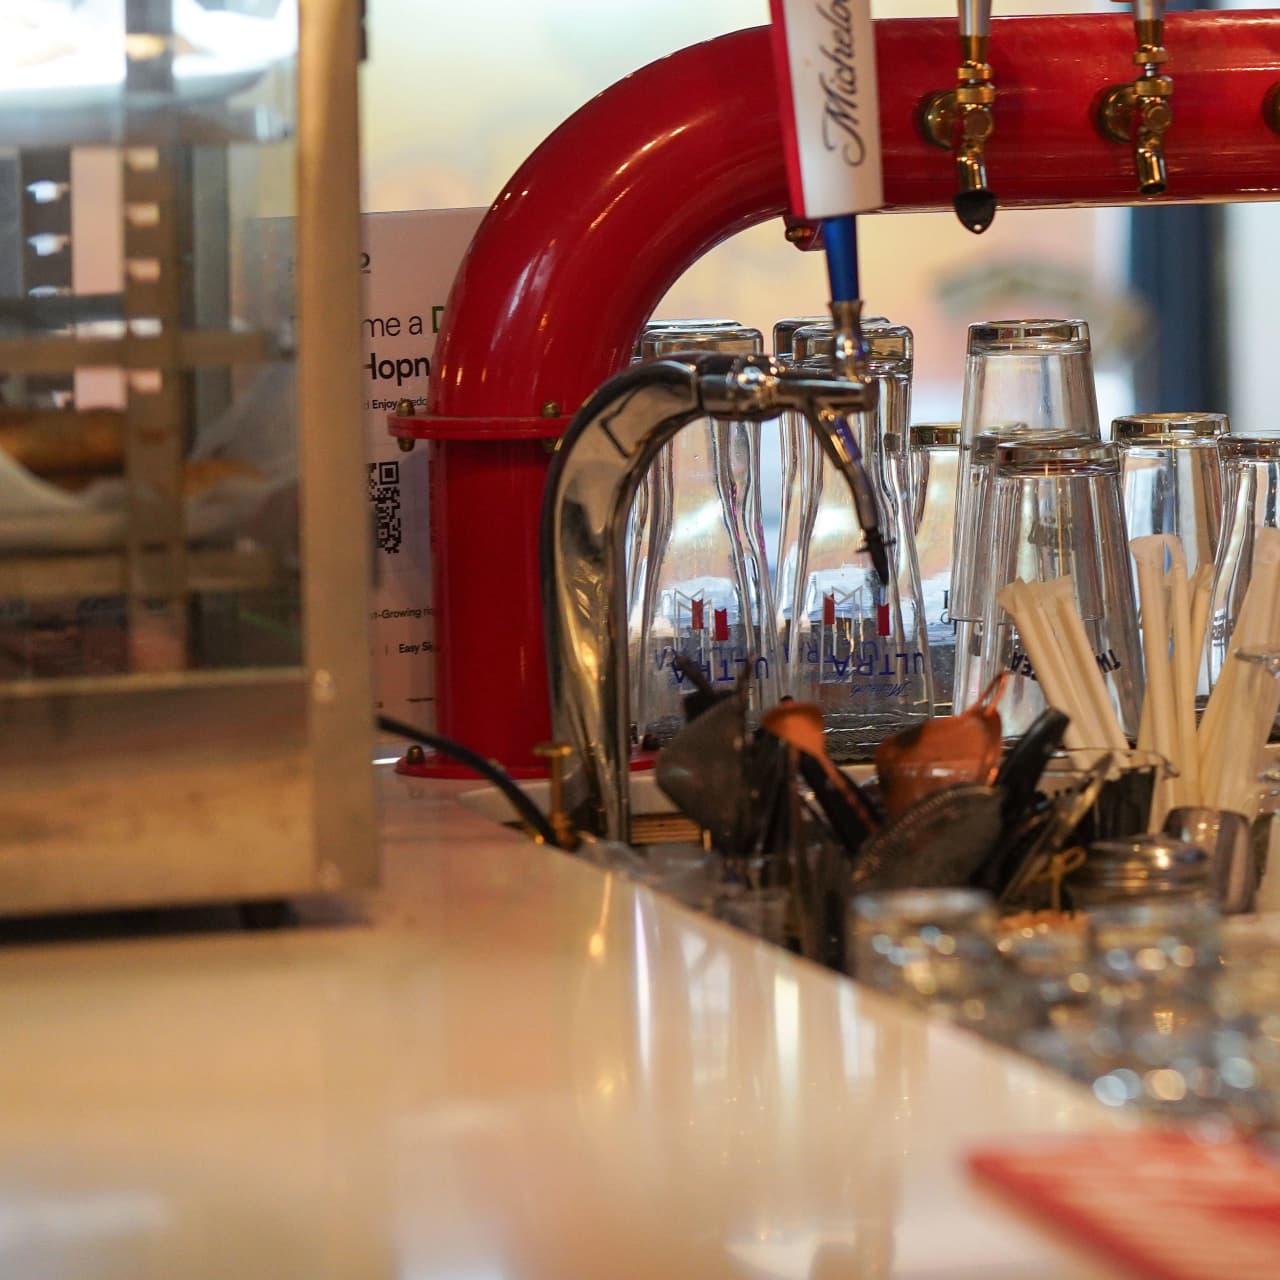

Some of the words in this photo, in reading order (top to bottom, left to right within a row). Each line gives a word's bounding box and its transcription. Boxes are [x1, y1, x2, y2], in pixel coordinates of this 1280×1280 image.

[408, 315, 423, 336] a
[372, 399, 398, 411] Enjoy
[399, 643, 421, 655] Easy
[830, 651, 926, 677] ULTRA
